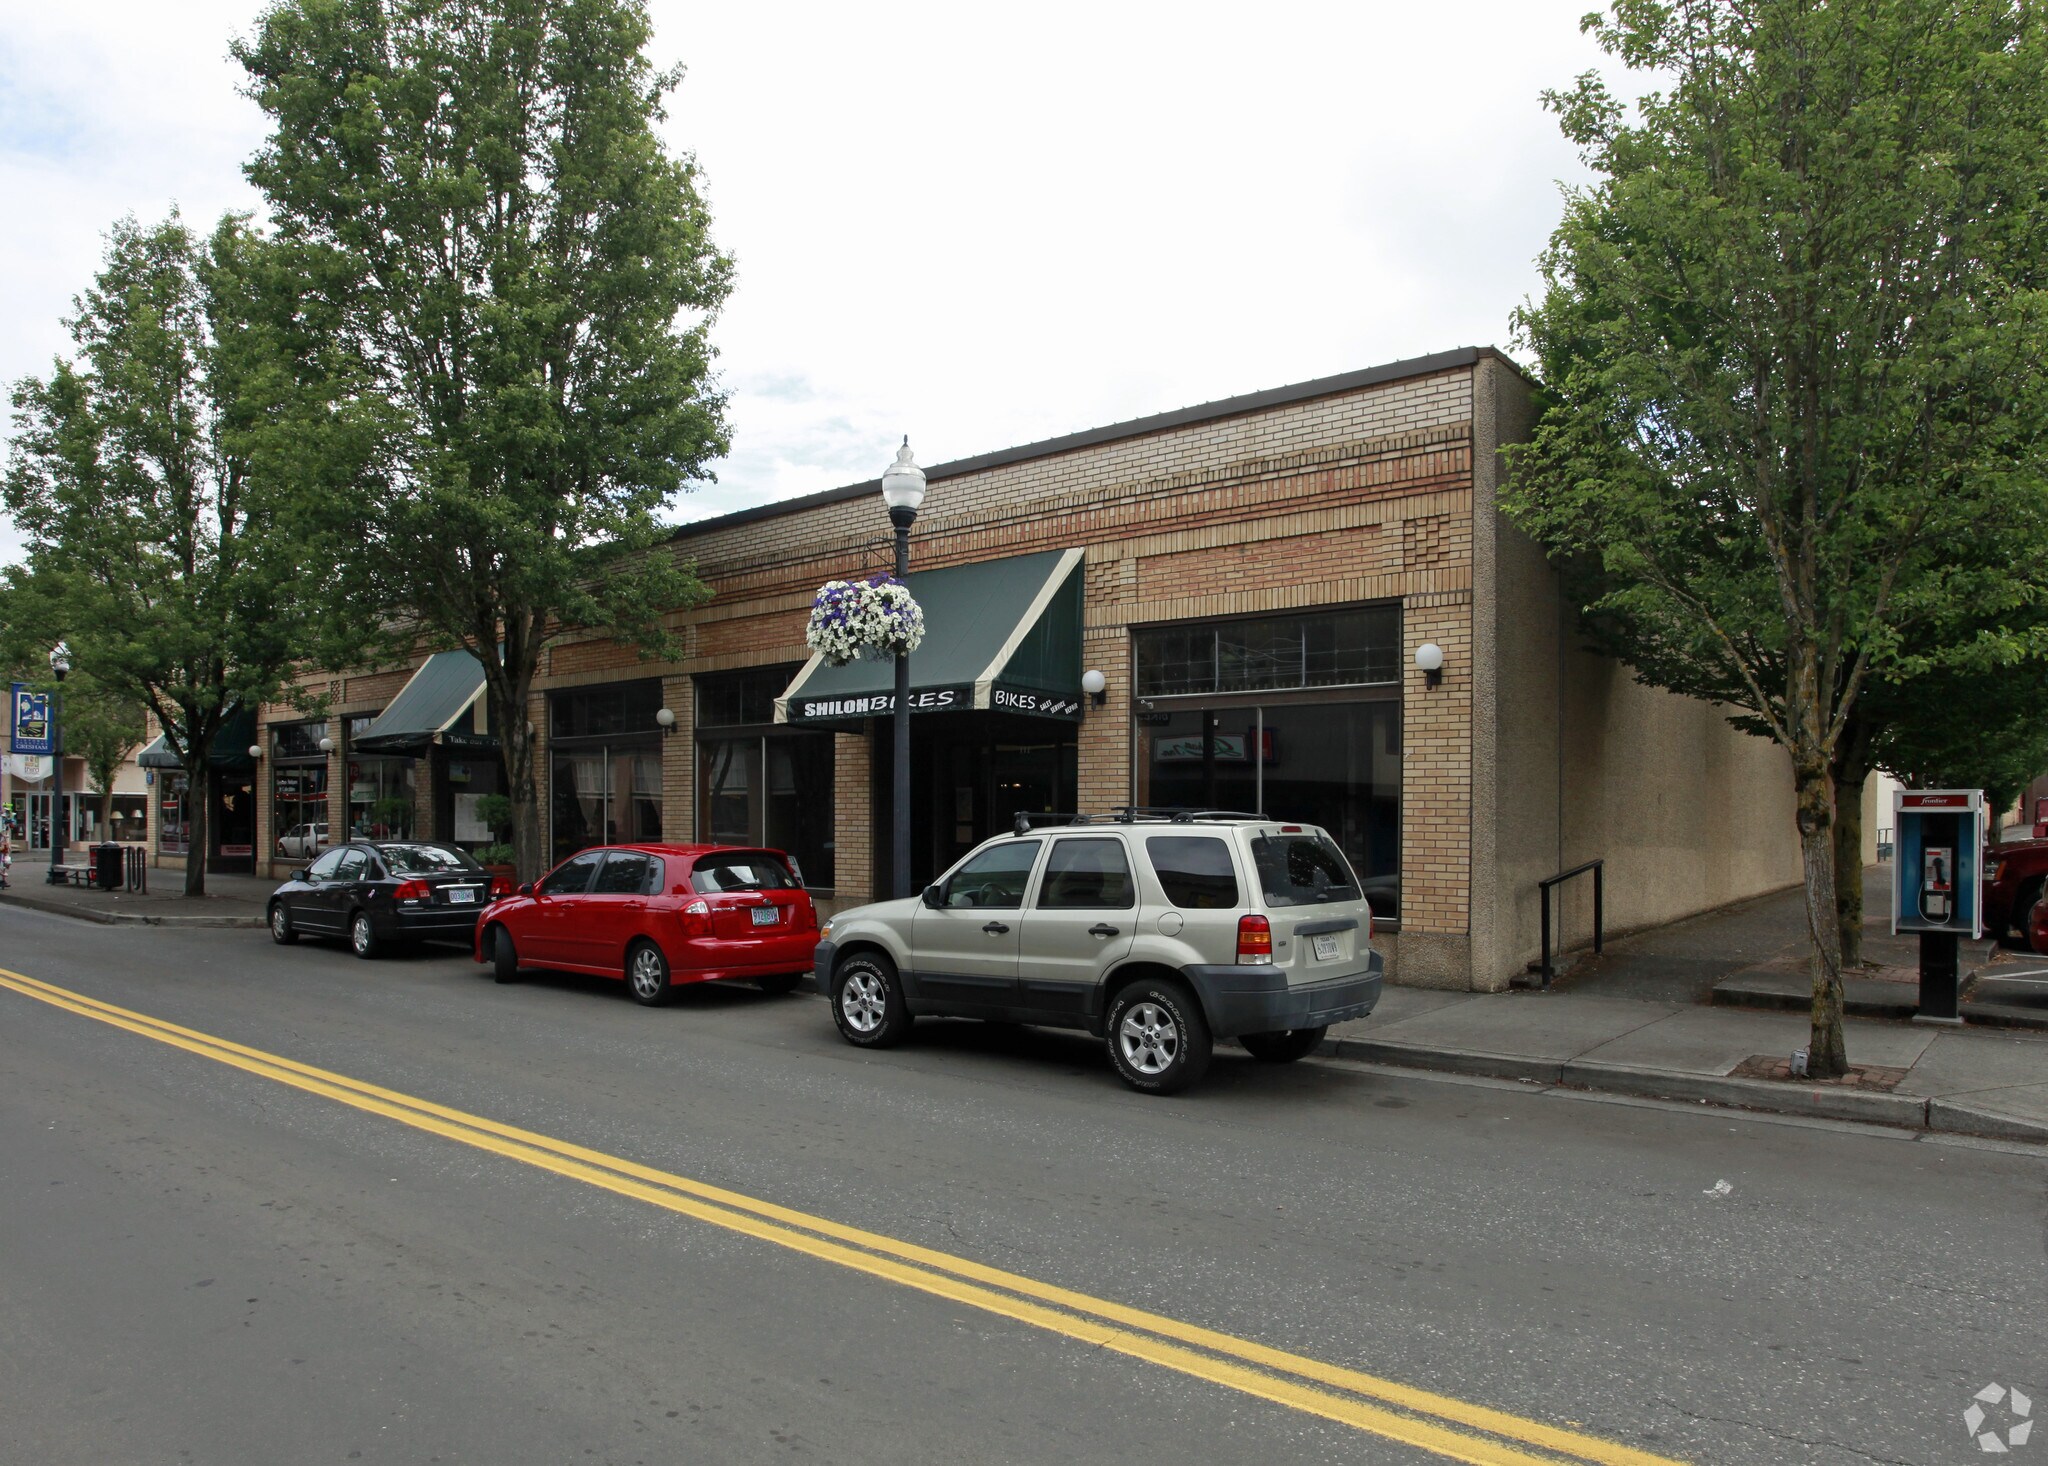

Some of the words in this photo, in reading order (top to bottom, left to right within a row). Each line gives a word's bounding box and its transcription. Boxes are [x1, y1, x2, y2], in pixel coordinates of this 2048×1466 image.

[995, 689, 1036, 710] BIKES
[1039, 699, 1053, 712] SALES
[1049, 699, 1066, 714] SERVICE
[804, 698, 869, 717] SHILOH
[1064, 702, 1079, 715] REPAIR
[448, 735, 468, 744] Take
